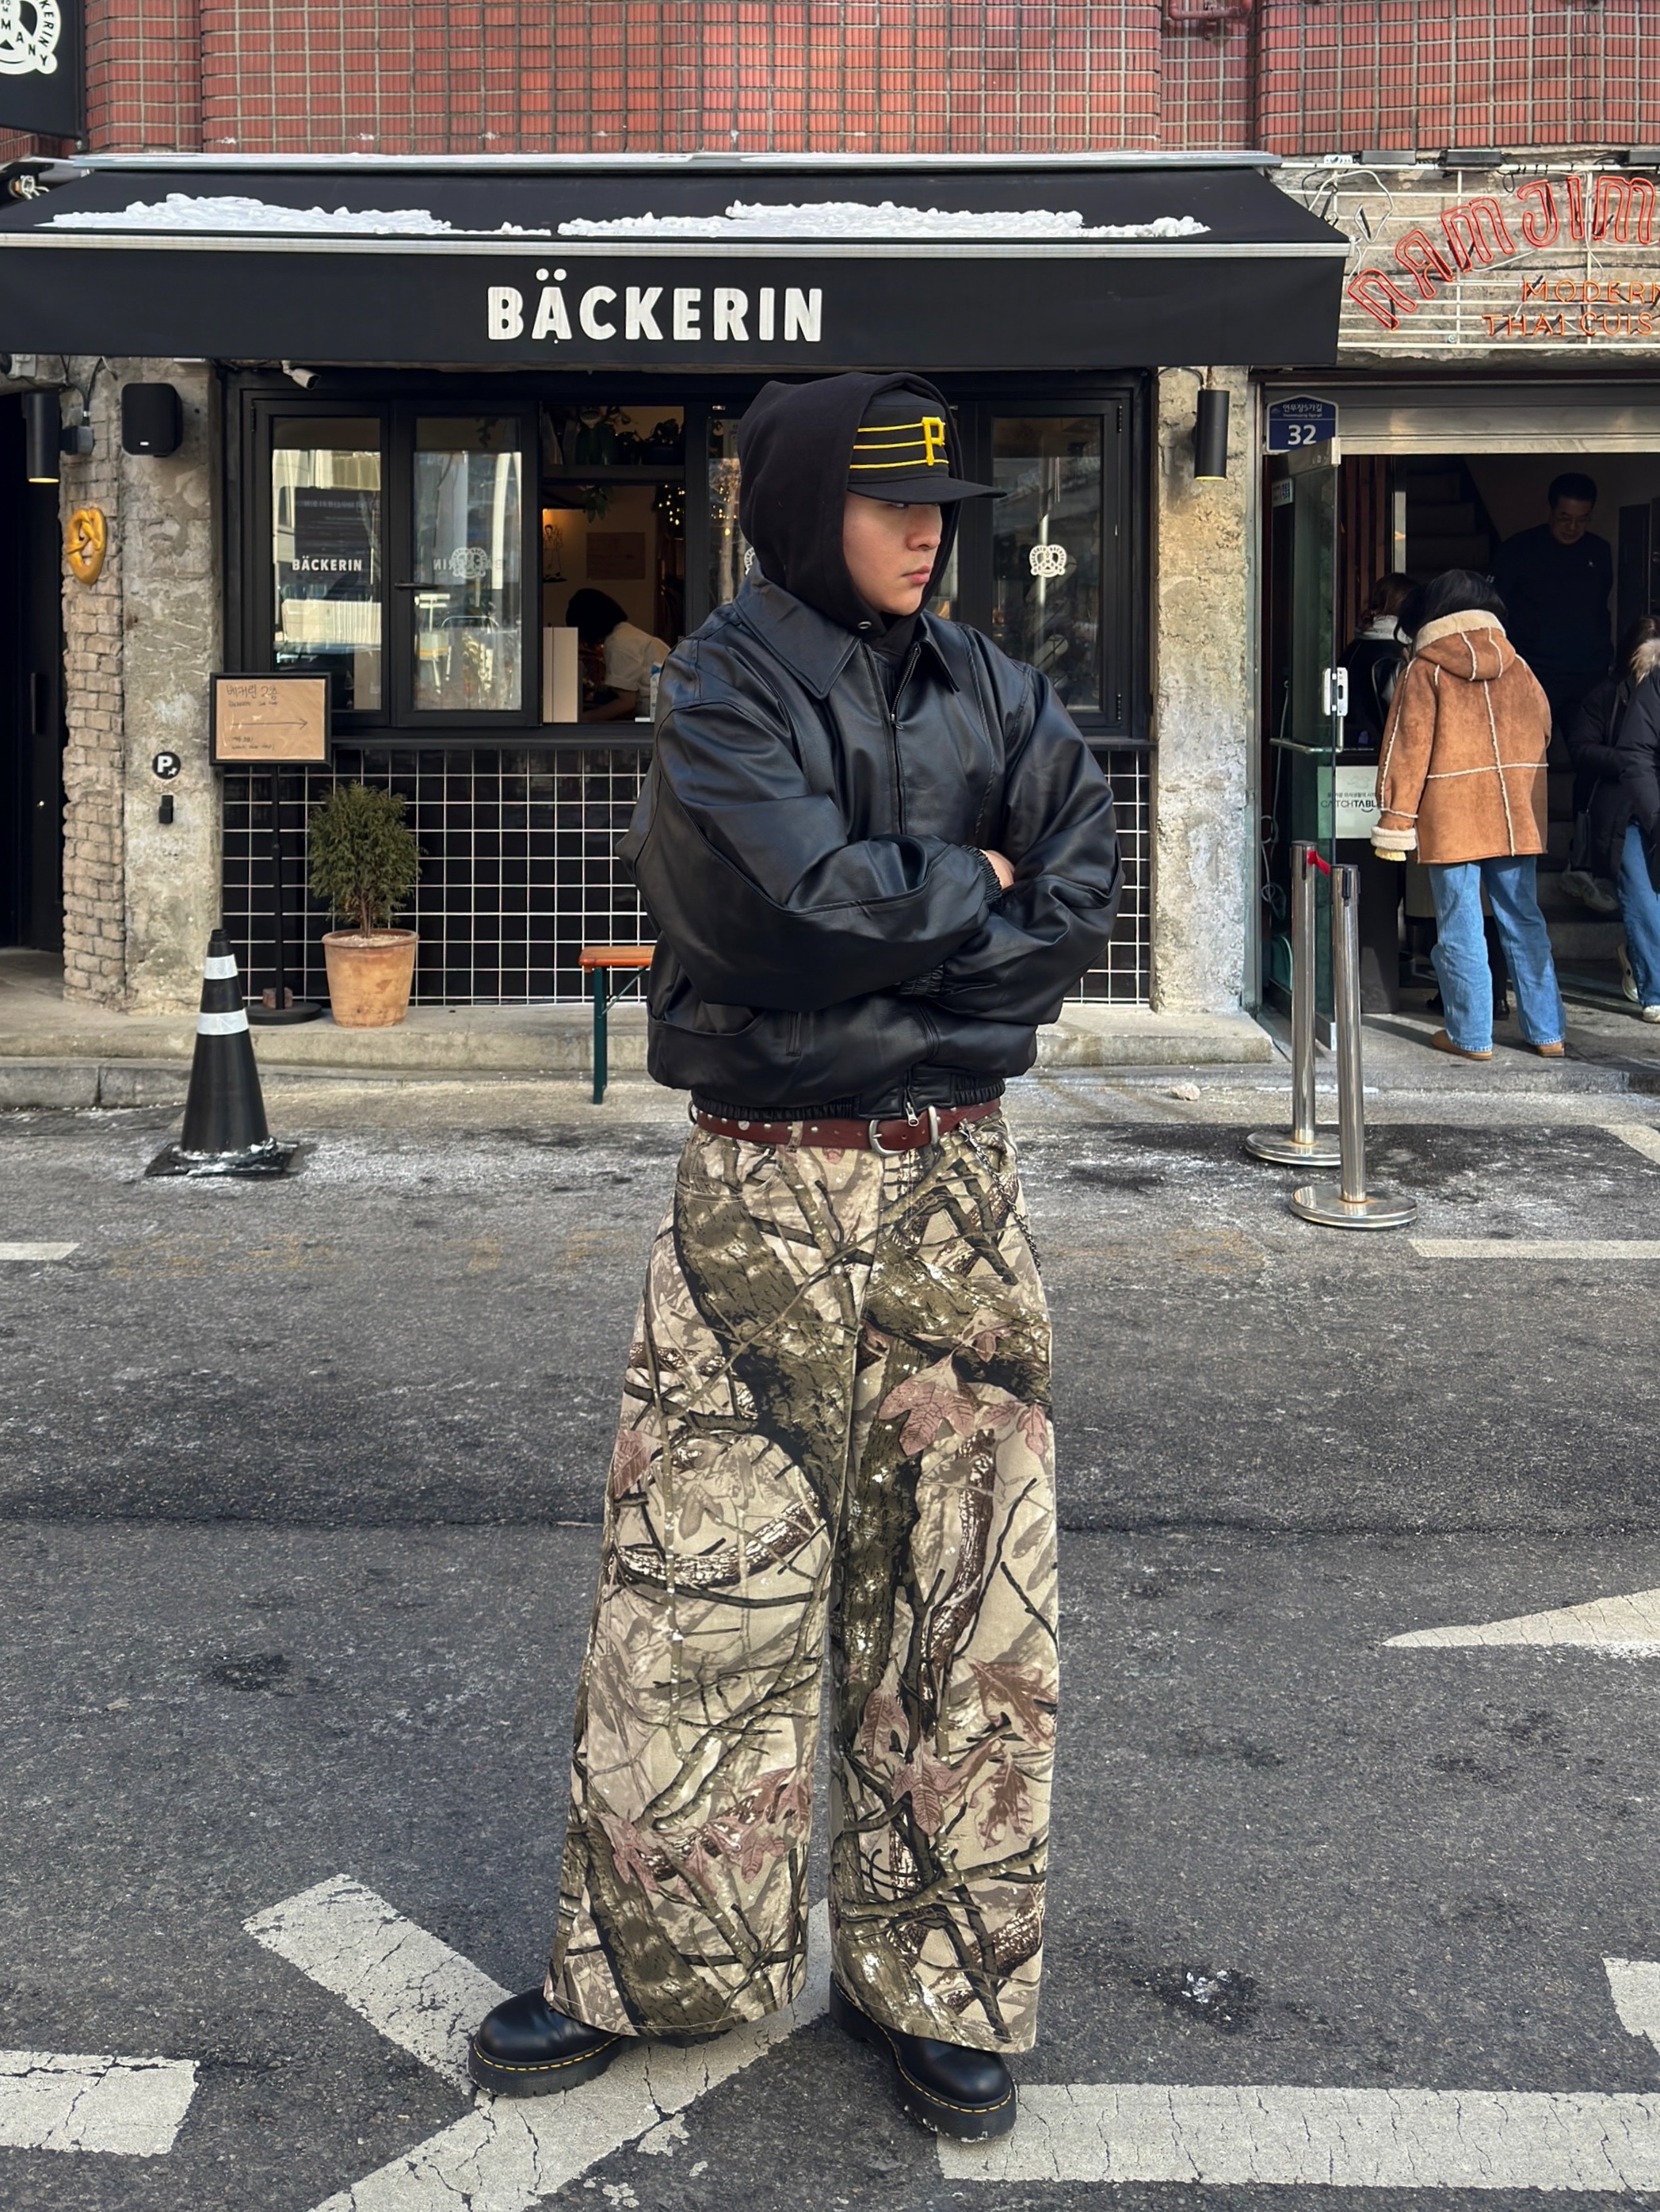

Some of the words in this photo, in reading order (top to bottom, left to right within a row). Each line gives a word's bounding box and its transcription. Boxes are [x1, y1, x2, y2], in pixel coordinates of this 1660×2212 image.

[487, 268, 822, 342] BÄCKERIN
[1483, 312, 1566, 337] THAI
[1579, 311, 1660, 337] CUIS
[922, 416, 945, 466] P
[1288, 424, 1317, 445] 32
[292, 555, 362, 571] BÄCKERIN
[157, 755, 173, 774] P
[1320, 800, 1376, 808] CATCHTABL
